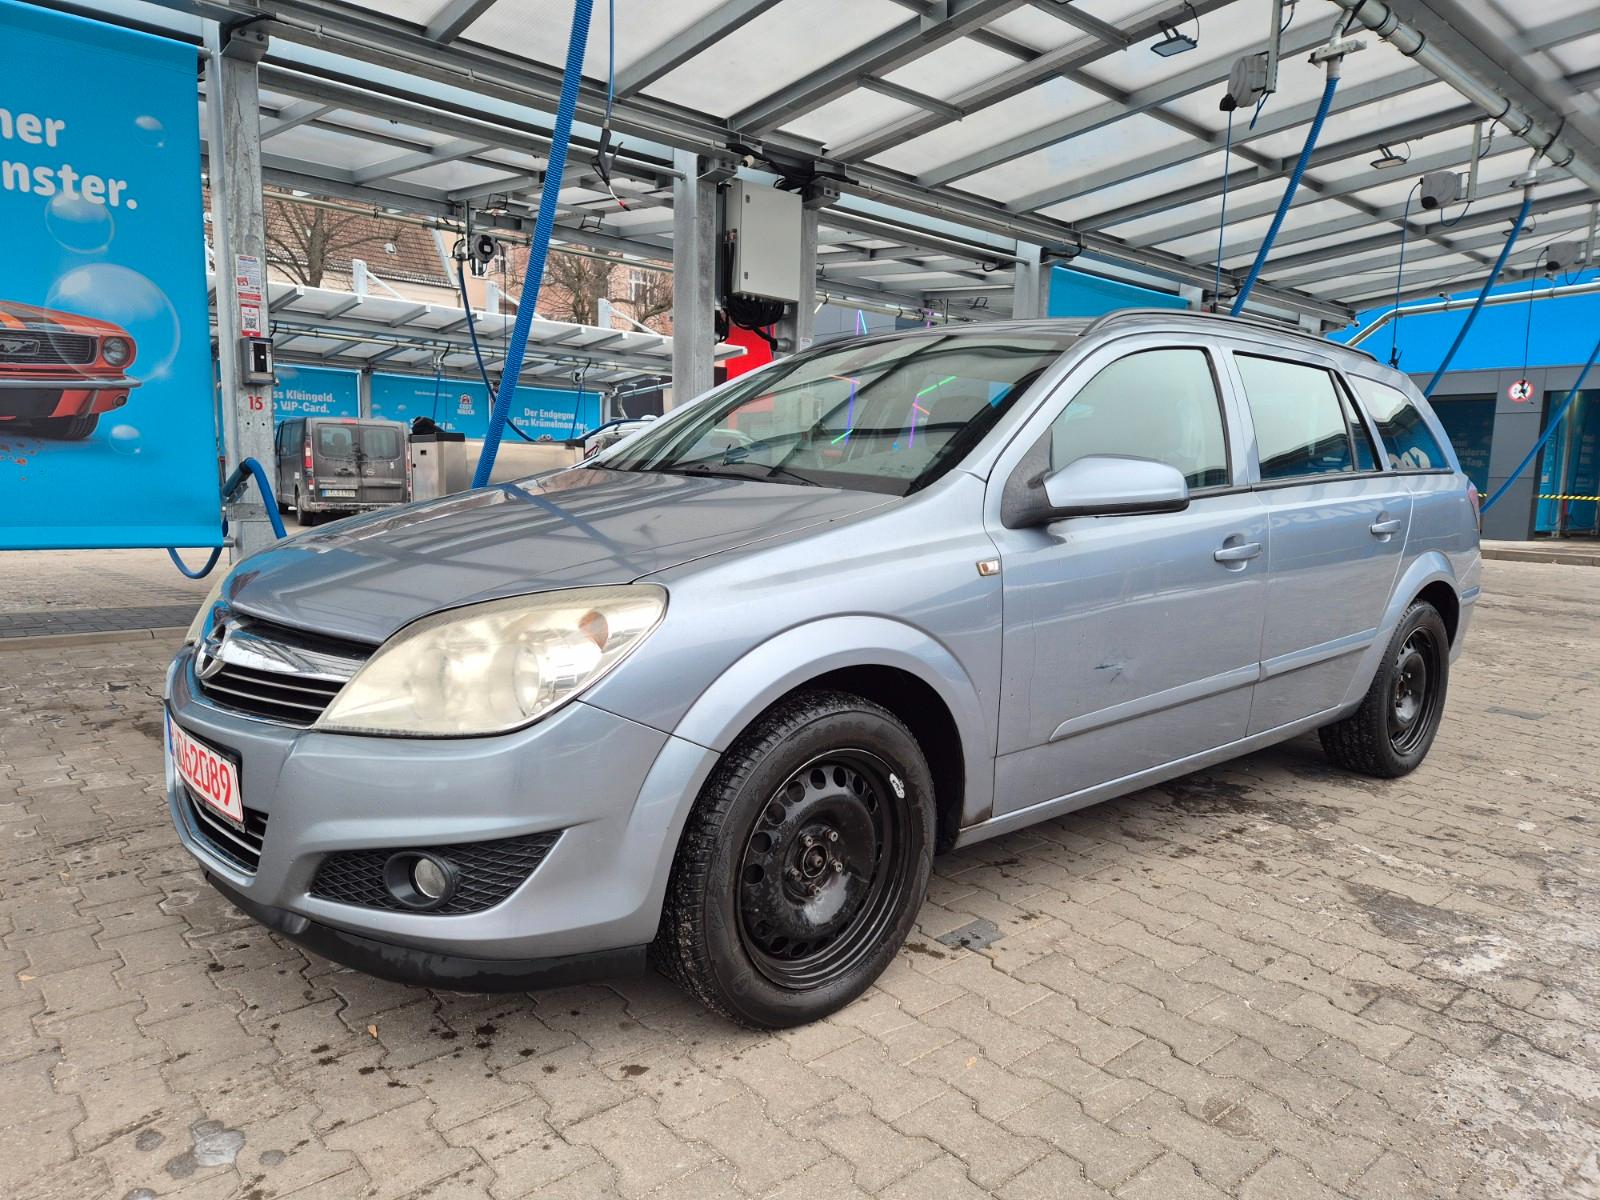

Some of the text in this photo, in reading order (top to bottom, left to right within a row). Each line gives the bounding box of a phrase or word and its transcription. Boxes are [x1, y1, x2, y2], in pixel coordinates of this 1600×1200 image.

[2, 160, 138, 210] nster.
[286, 389, 336, 403] Kleingeld.
[248, 396, 263, 410] 15
[280, 400, 330, 413] VIP-Card.
[524, 408, 576, 420] Der Endgegne
[531, 418, 588, 430] Krümelmonter.
